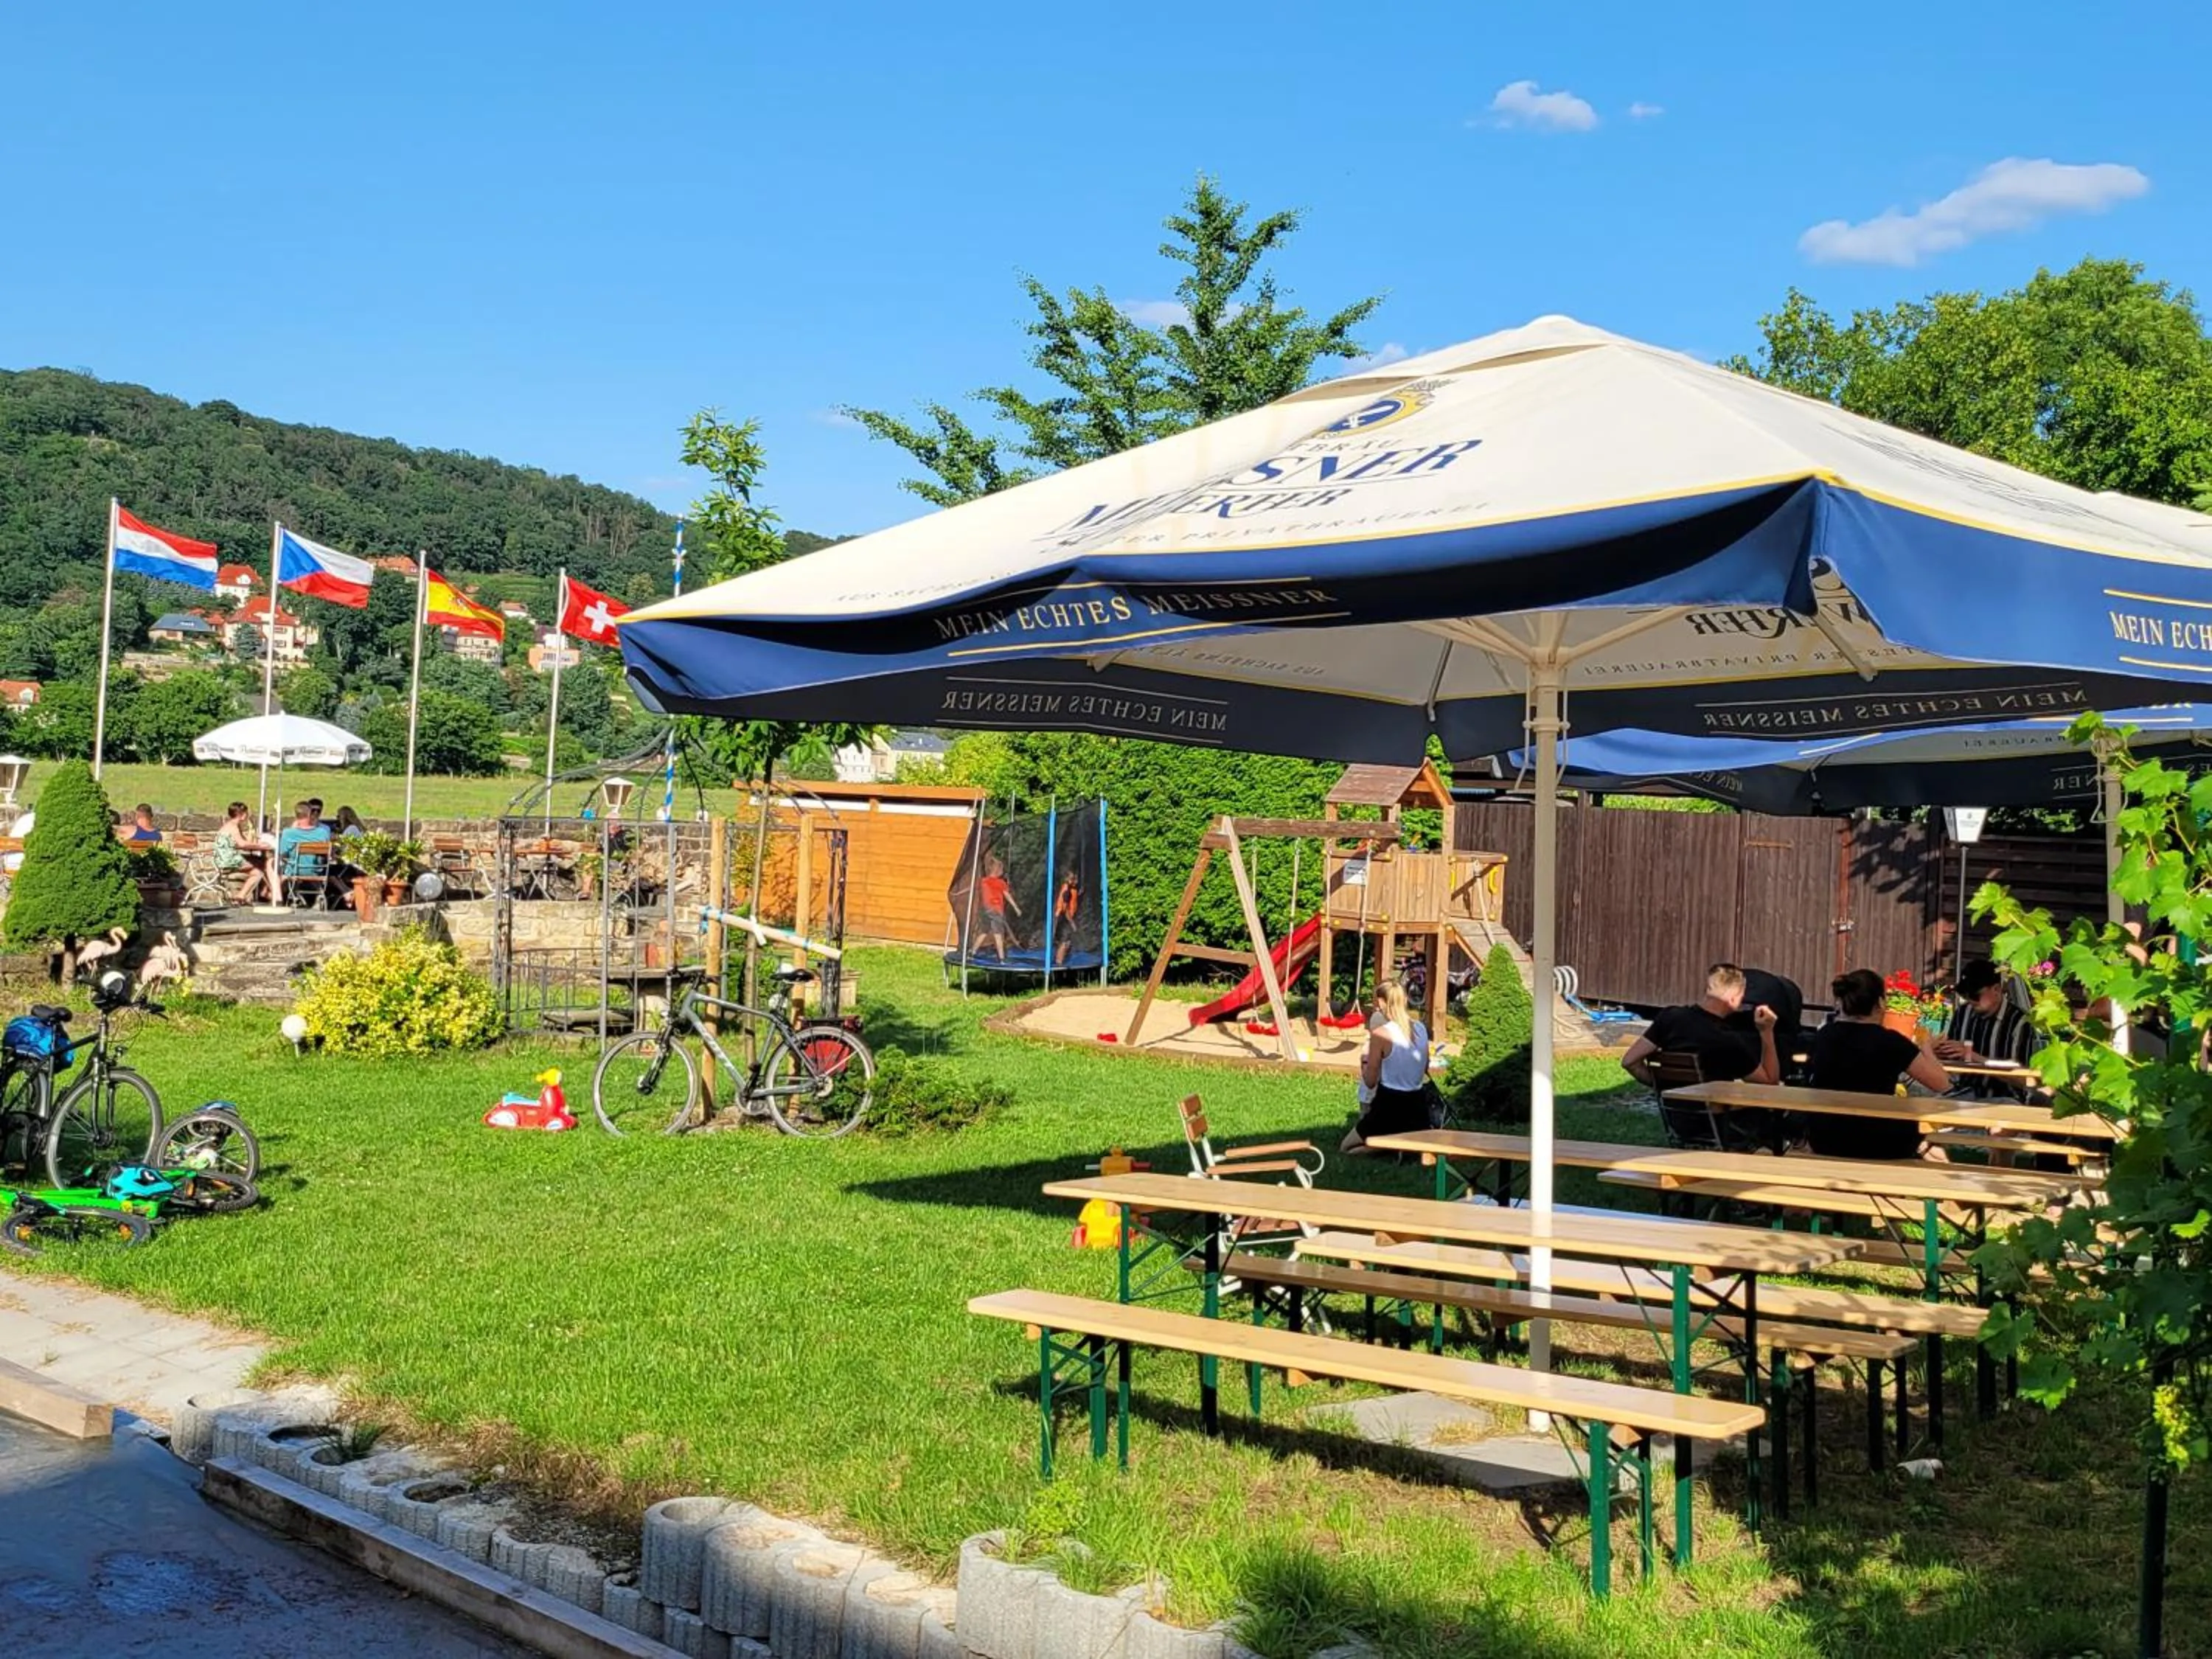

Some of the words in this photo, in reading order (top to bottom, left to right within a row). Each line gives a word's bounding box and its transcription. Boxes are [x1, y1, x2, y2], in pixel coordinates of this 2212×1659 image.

[934, 609, 1010, 639] MEIN
[1017, 596, 1133, 630] ECHTES
[1141, 589, 1339, 616] MEISSNER
[2108, 611, 2165, 647] MEIN
[2168, 621, 2212, 652] ECH
